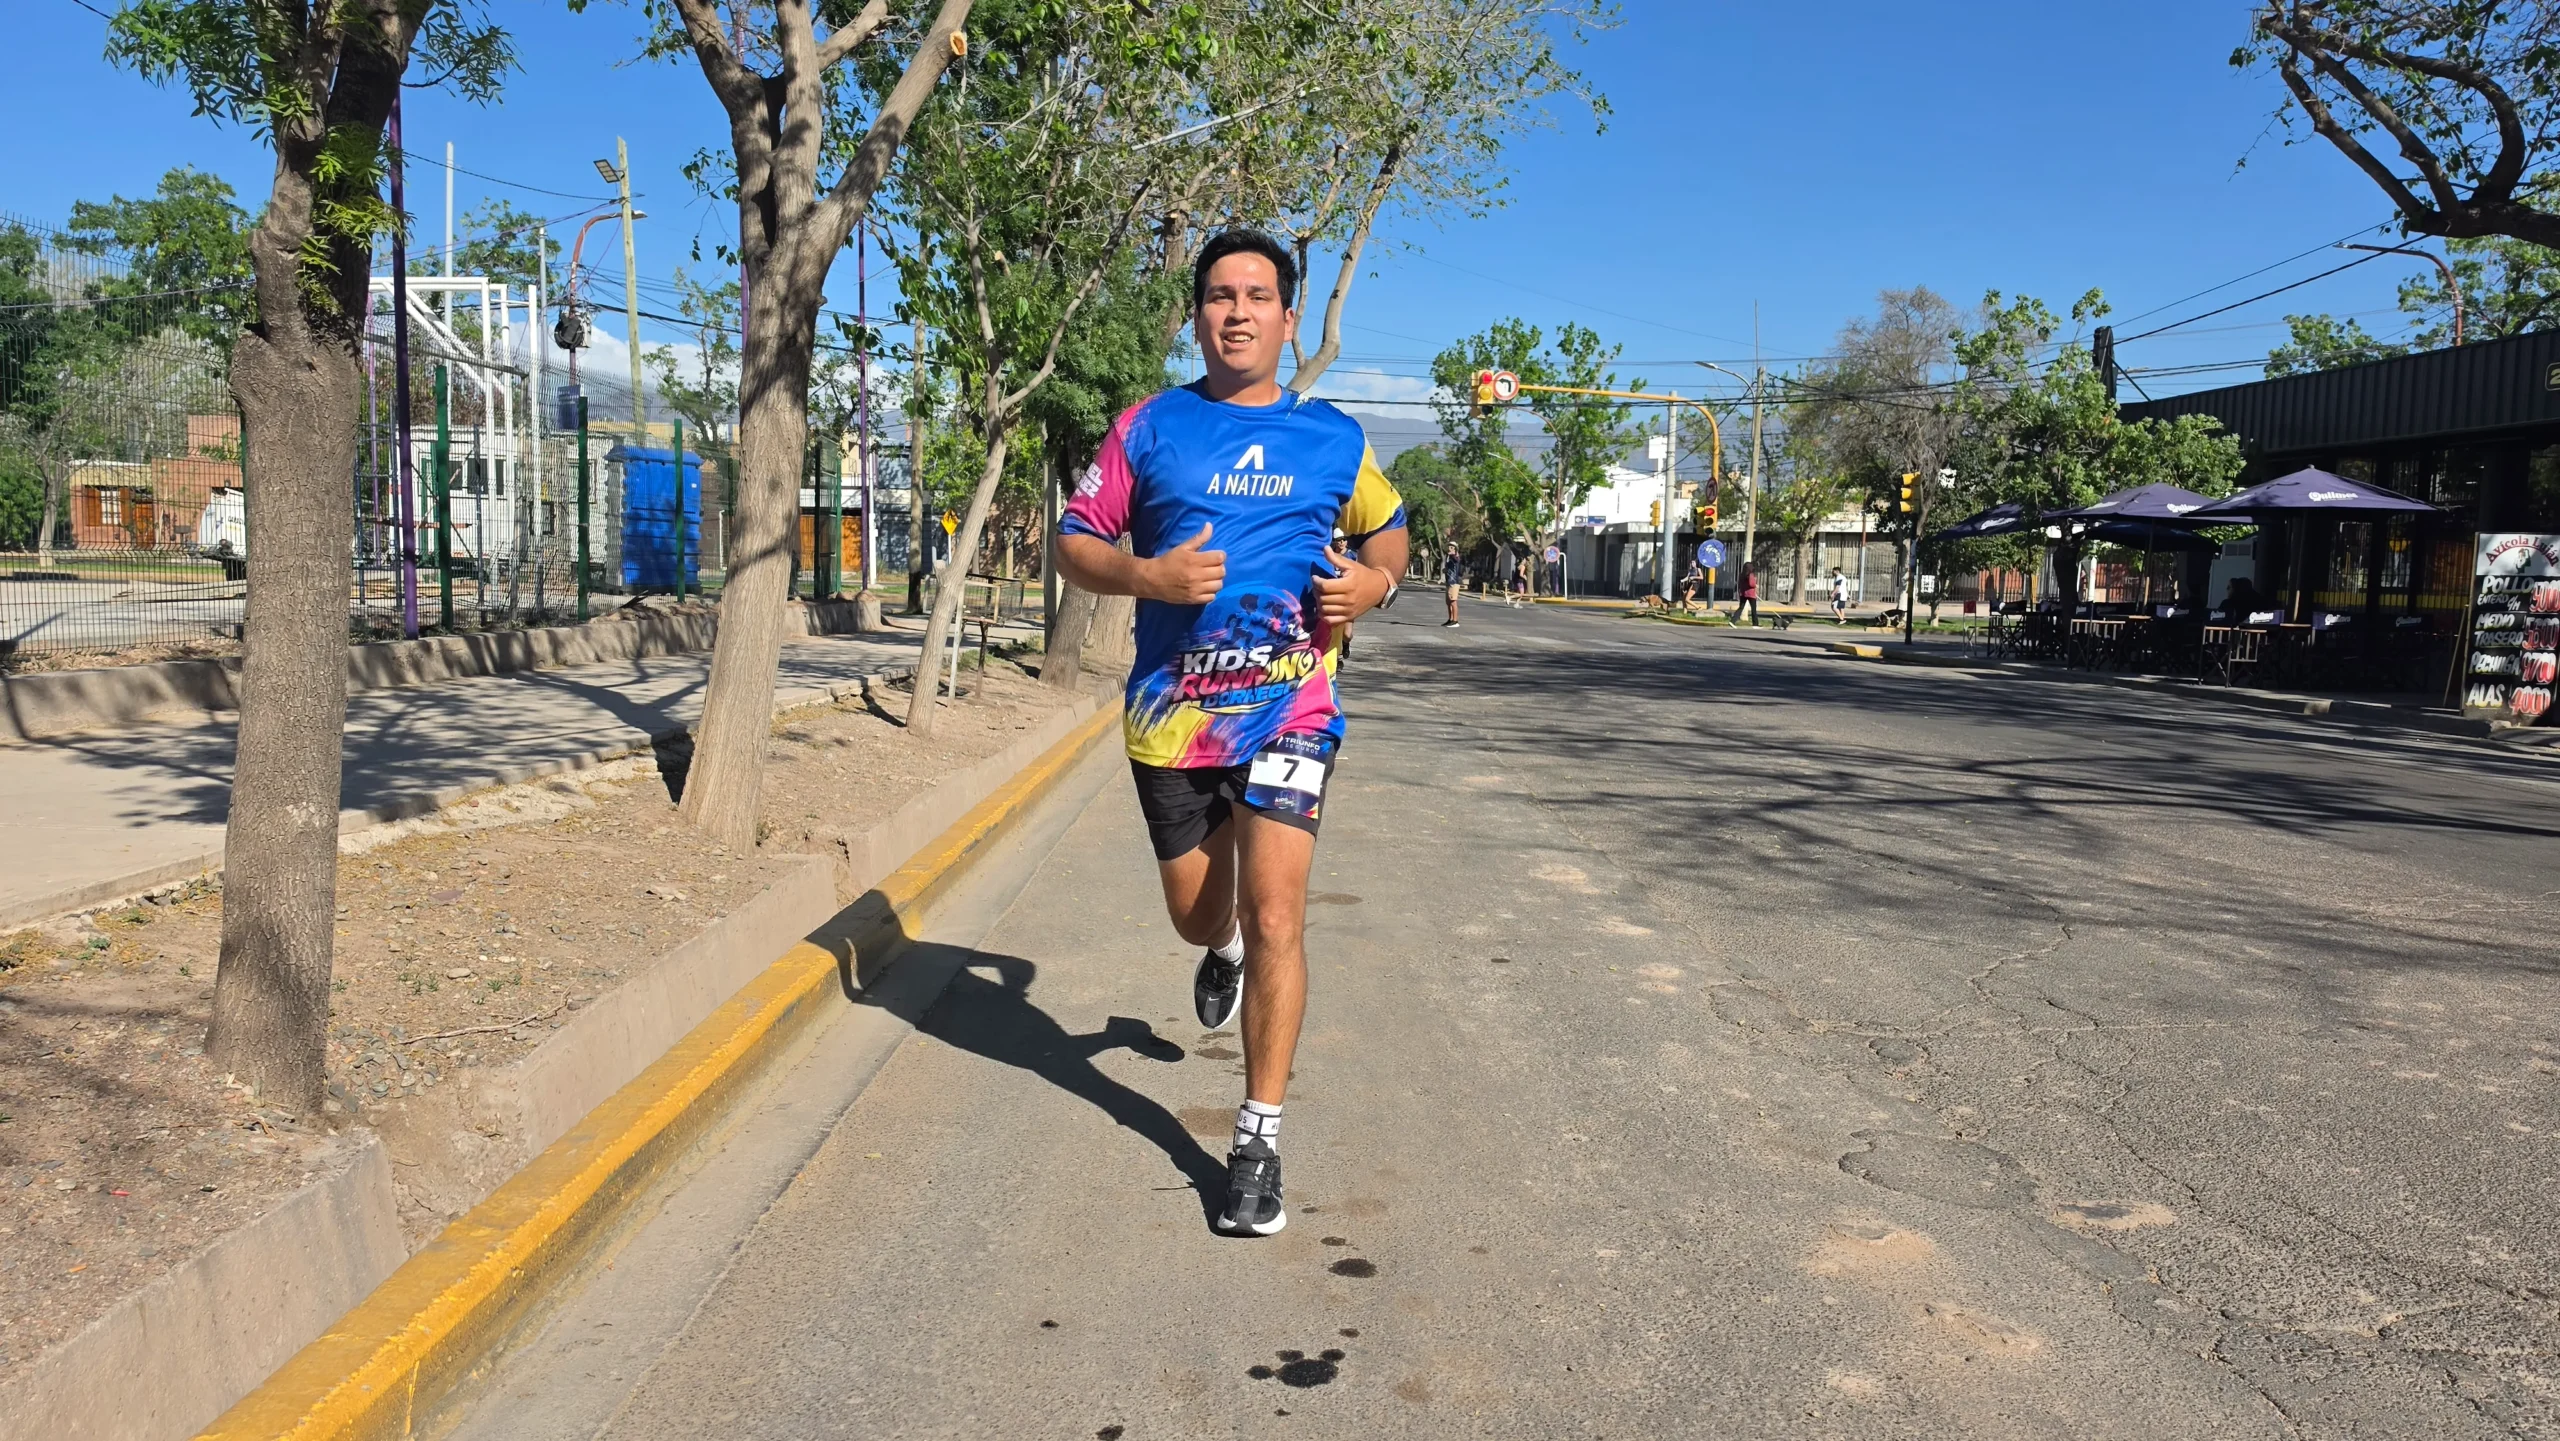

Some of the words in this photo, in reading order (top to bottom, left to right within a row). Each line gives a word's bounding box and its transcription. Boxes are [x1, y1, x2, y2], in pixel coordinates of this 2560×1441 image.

[1206, 472, 1220, 495] A
[1223, 473, 1294, 497] NATION
[2486, 535, 2529, 566] Avícola
[2532, 536, 2560, 568] Luján
[2482, 575, 2535, 595] POLLO
[2477, 593, 2510, 606] ENTERO
[2475, 613, 2515, 630] MEDIO
[2521, 616, 2560, 650] 5600
[2474, 630, 2524, 648] TRASERO
[1182, 645, 1273, 675] KIDS
[1173, 650, 1317, 702] RUNNING
[2465, 683, 2505, 708] ALAS
[2508, 685, 2552, 715] 4000
[1285, 737, 1321, 751] TRIUNFO
[1285, 743, 1319, 755] SEGUROS
[1282, 757, 1300, 783] 7
